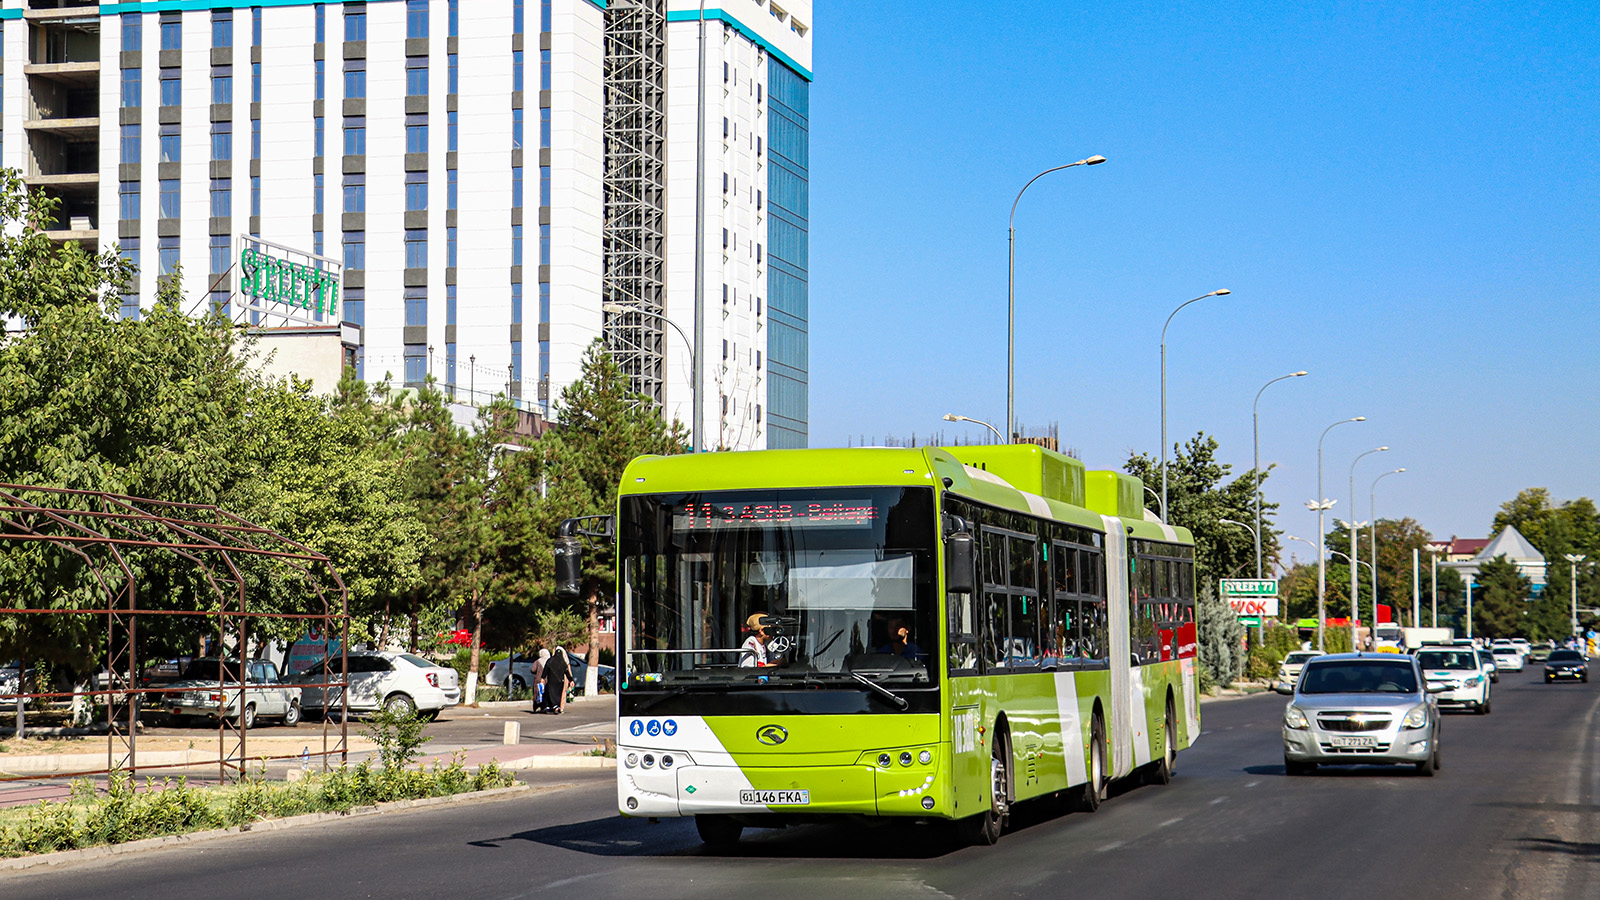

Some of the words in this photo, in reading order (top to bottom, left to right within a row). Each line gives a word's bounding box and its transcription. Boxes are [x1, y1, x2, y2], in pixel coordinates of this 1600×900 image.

[242, 248, 314, 310] STREET
[314, 268, 340, 316] 77
[684, 503, 712, 529] 11
[1224, 581, 1261, 592] STREET
[1261, 581, 1274, 592] 77
[1231, 600, 1267, 614] WOK
[742, 793, 753, 802] 01
[755, 792, 776, 803] 146
[778, 792, 802, 803] FKA
